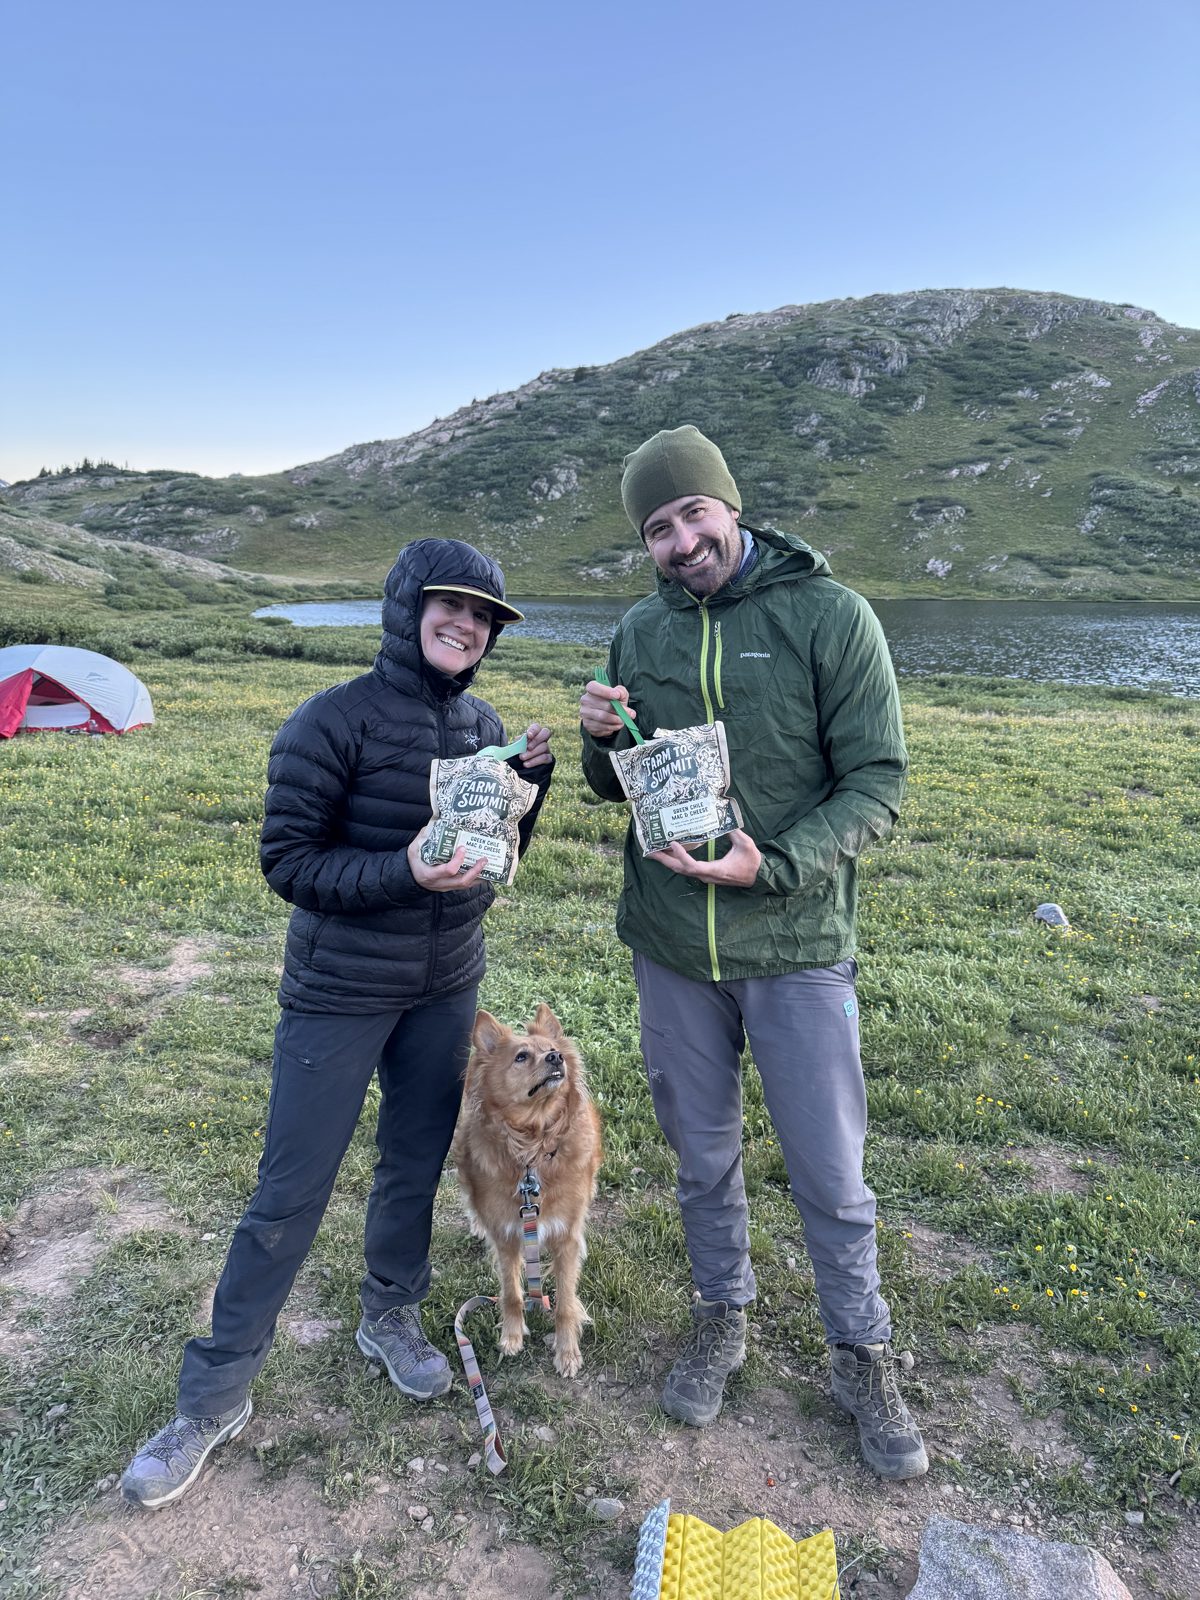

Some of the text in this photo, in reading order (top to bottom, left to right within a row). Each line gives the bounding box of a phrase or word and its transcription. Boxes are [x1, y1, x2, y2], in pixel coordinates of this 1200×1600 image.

[740, 651, 771, 659] patagonia
[642, 744, 688, 777] FARM TO
[650, 756, 693, 788] SUMMIT
[459, 779, 509, 797] FARM TO
[457, 792, 509, 811] SUMMIT
[690, 801, 704, 810] CHILE
[689, 806, 709, 816] CHEESE
